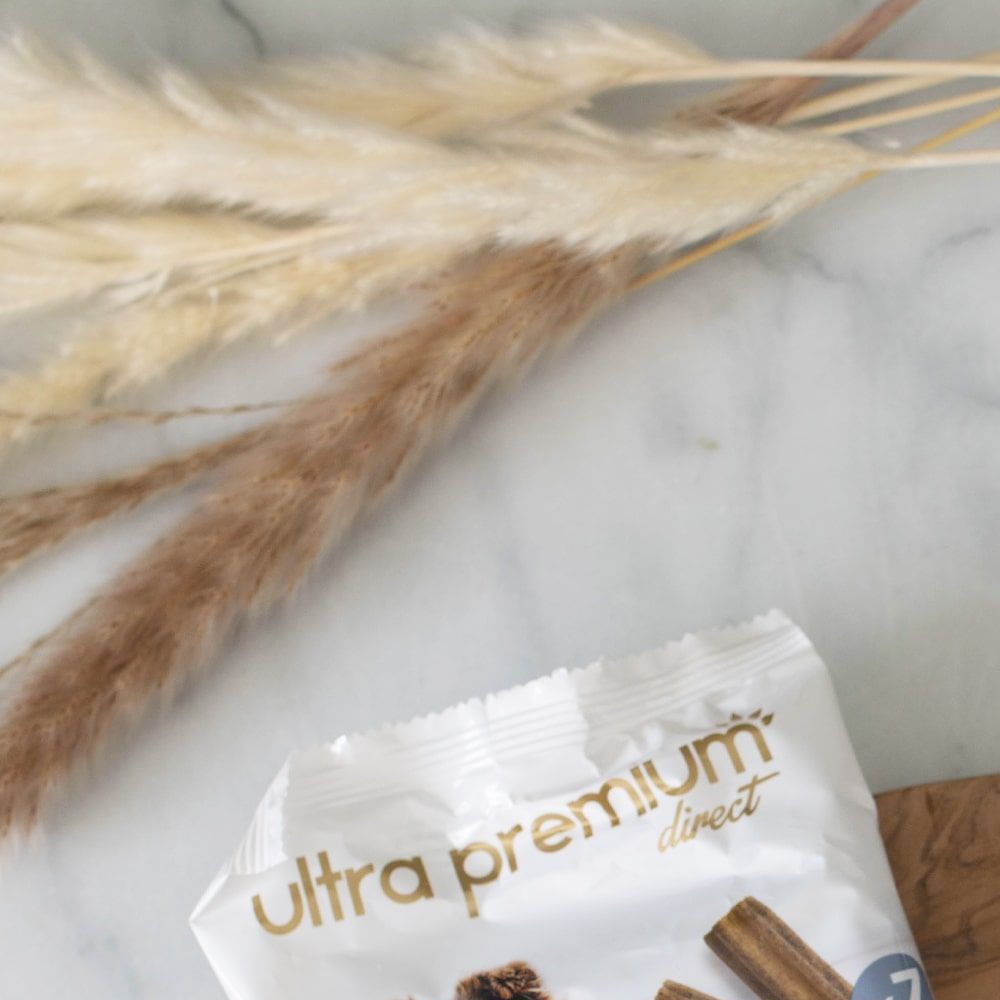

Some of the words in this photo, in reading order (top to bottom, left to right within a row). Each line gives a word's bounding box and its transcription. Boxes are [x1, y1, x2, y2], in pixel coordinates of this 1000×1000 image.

[251, 851, 434, 935] ultra
[449, 716, 774, 918] premium
[657, 771, 780, 854] direct
